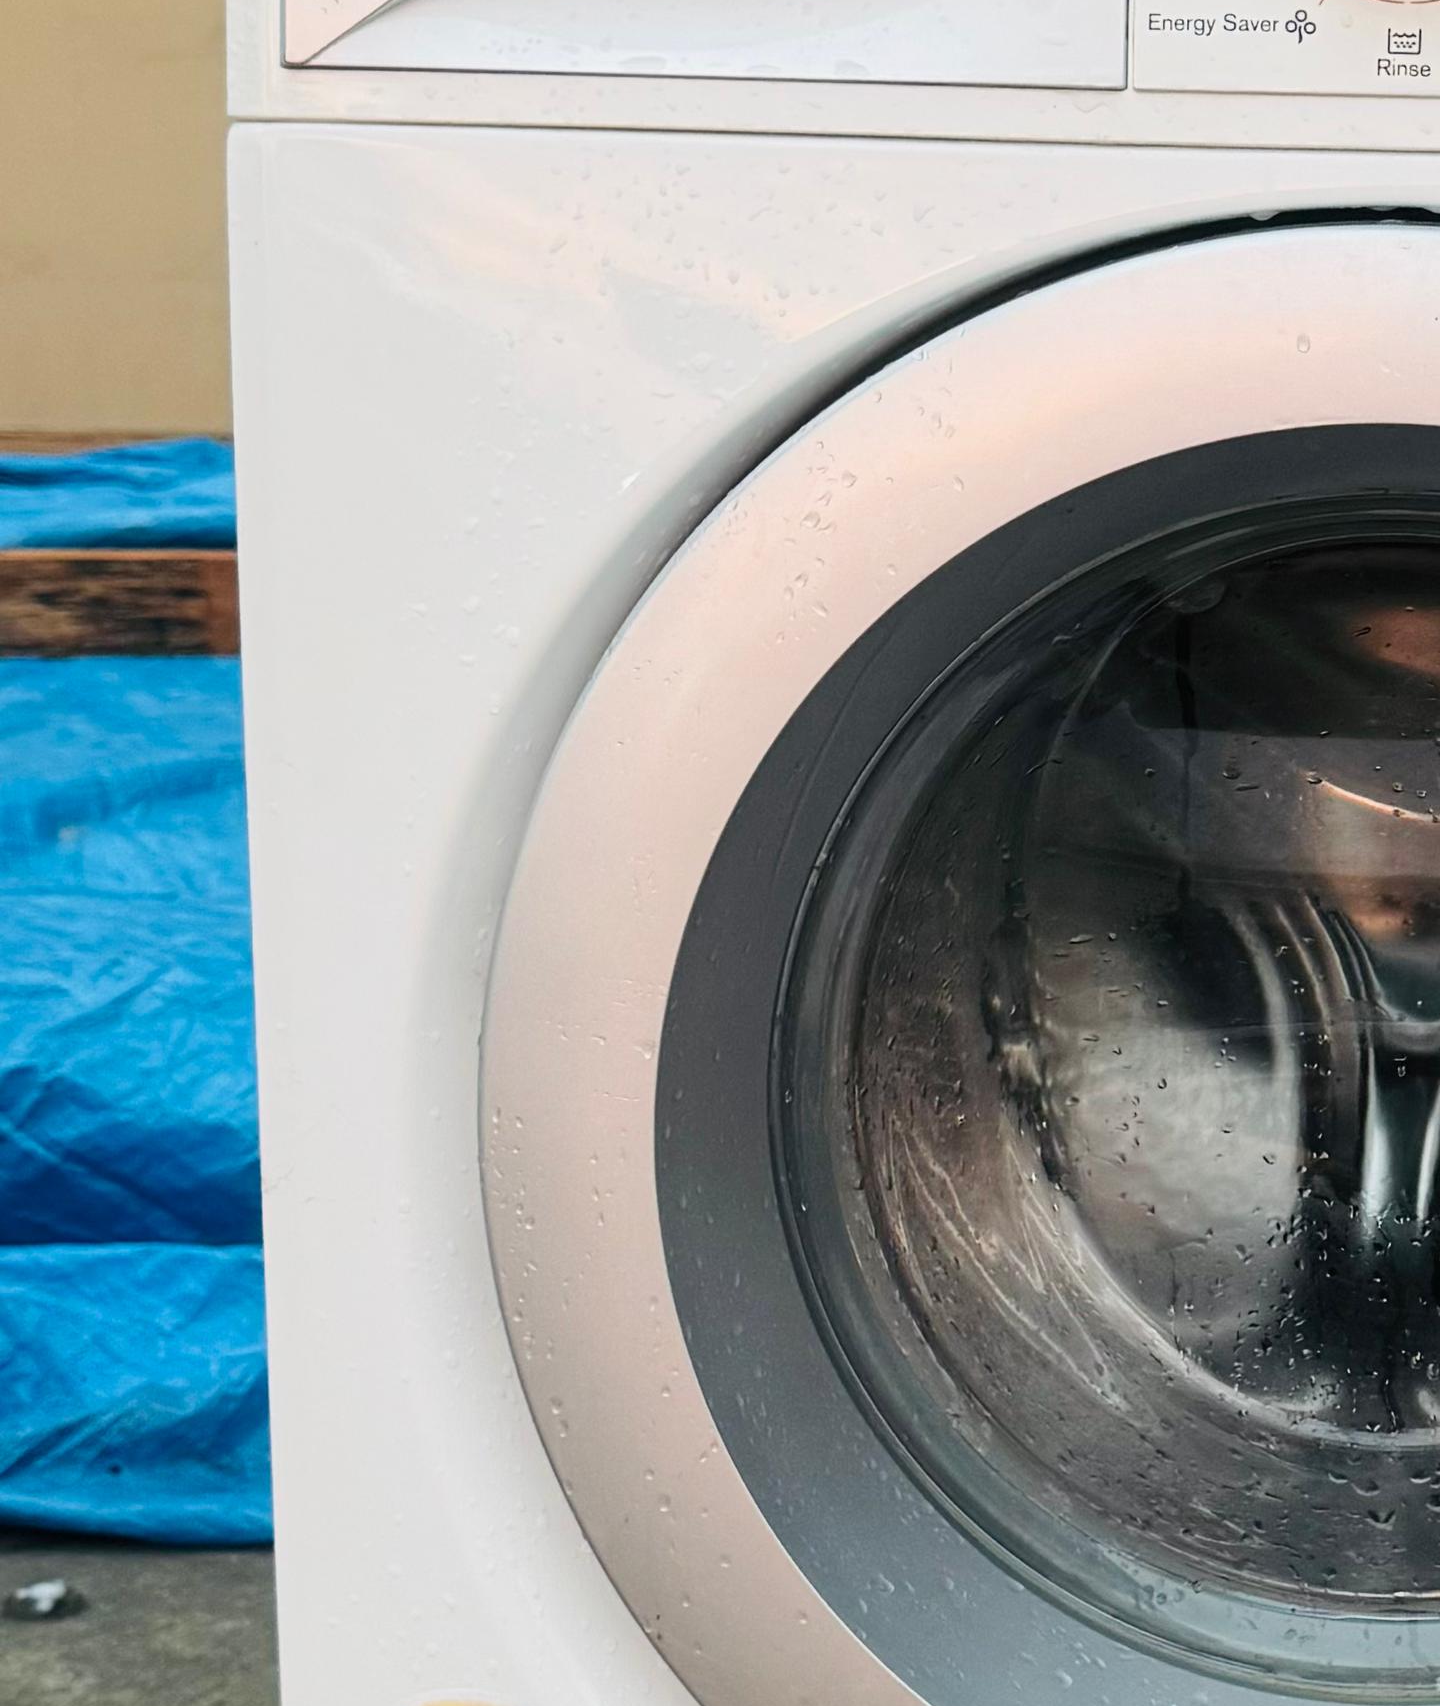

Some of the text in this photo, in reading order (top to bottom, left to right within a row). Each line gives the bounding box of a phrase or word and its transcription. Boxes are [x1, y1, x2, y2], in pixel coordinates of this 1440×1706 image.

[1148, 13, 1279, 36] Energy Saver
[1376, 58, 1431, 77] Rinse
